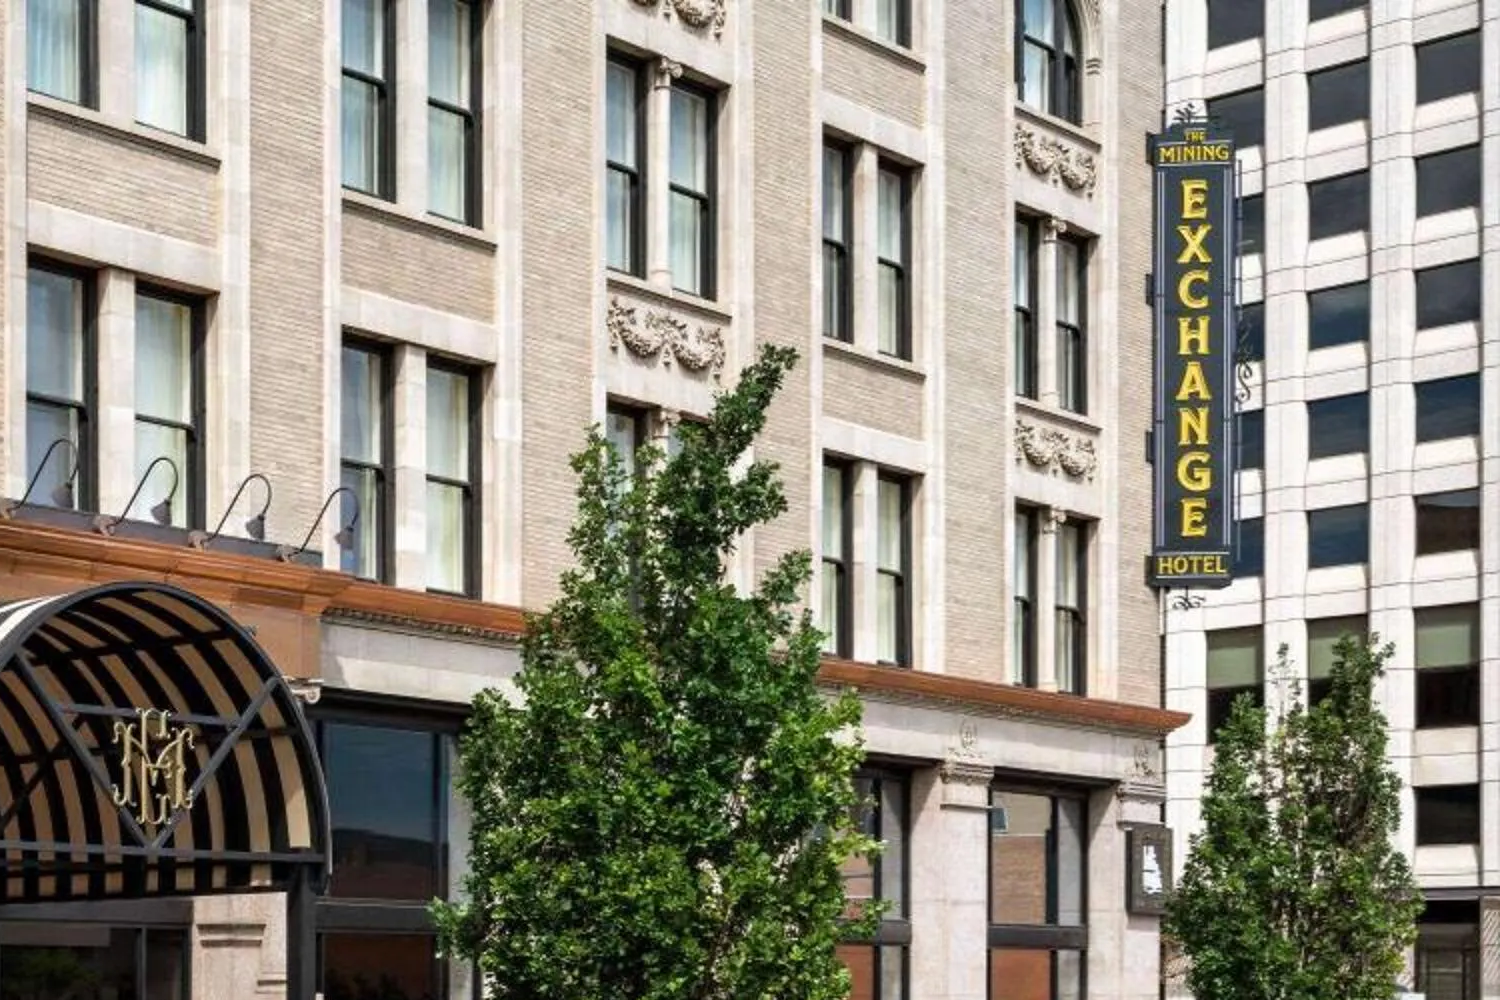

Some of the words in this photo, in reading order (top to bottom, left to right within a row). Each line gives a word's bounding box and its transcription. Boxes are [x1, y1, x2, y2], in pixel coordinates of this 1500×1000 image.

[1184, 128, 1207, 142] THE
[1159, 145, 1229, 162] MINING
[1176, 178, 1213, 538] EXCHANGE
[1157, 555, 1228, 574] HOTEL
